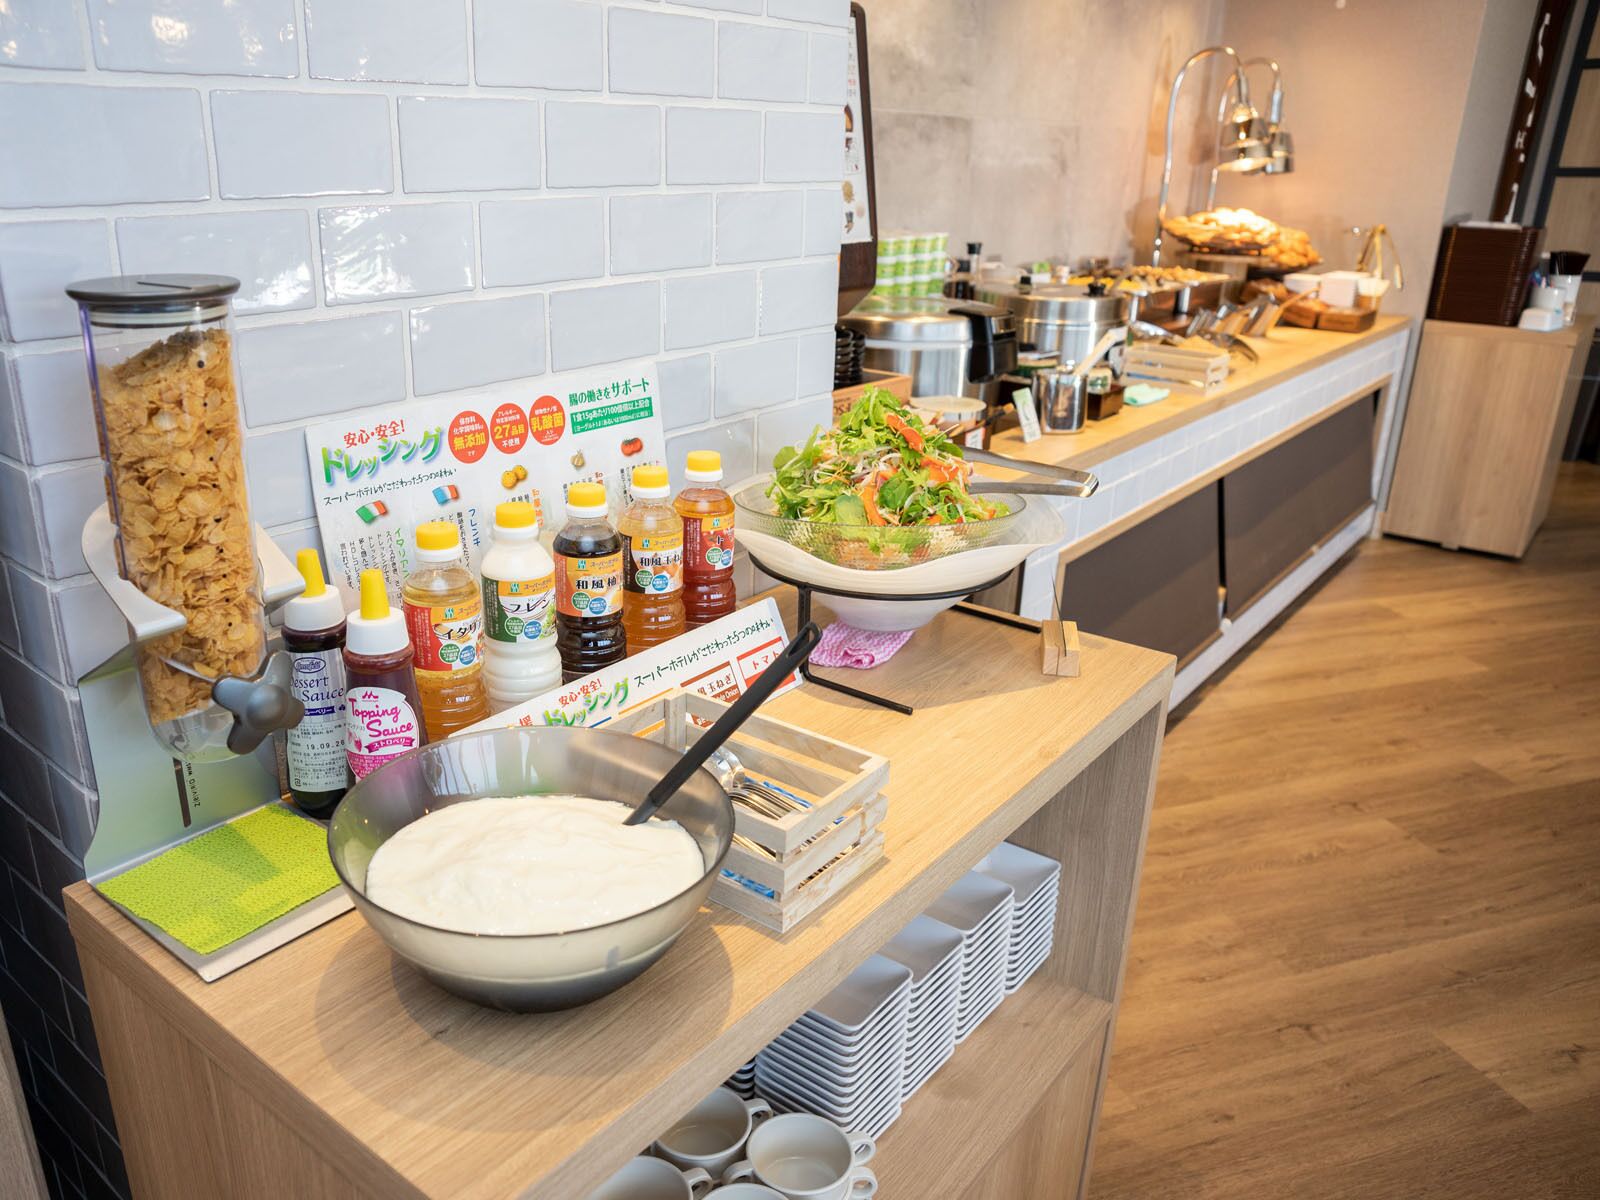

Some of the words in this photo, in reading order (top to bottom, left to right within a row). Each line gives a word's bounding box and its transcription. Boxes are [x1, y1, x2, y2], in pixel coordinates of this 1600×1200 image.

[569, 377, 650, 406] 腸の働きをサポート
[530, 412, 564, 432] 乳酸菌
[453, 432, 486, 450] 無添加
[493, 424, 525, 440] 27品目
[501, 438, 520, 448] 不使用
[321, 426, 442, 484] ドレッシング
[468, 508, 481, 547] フレンチ
[302, 687, 344, 702] Sauce
[543, 677, 629, 726] ドレッシング
[348, 698, 401, 723] Topping
[366, 719, 414, 738] Sauce
[373, 738, 412, 749] ストロベリー
